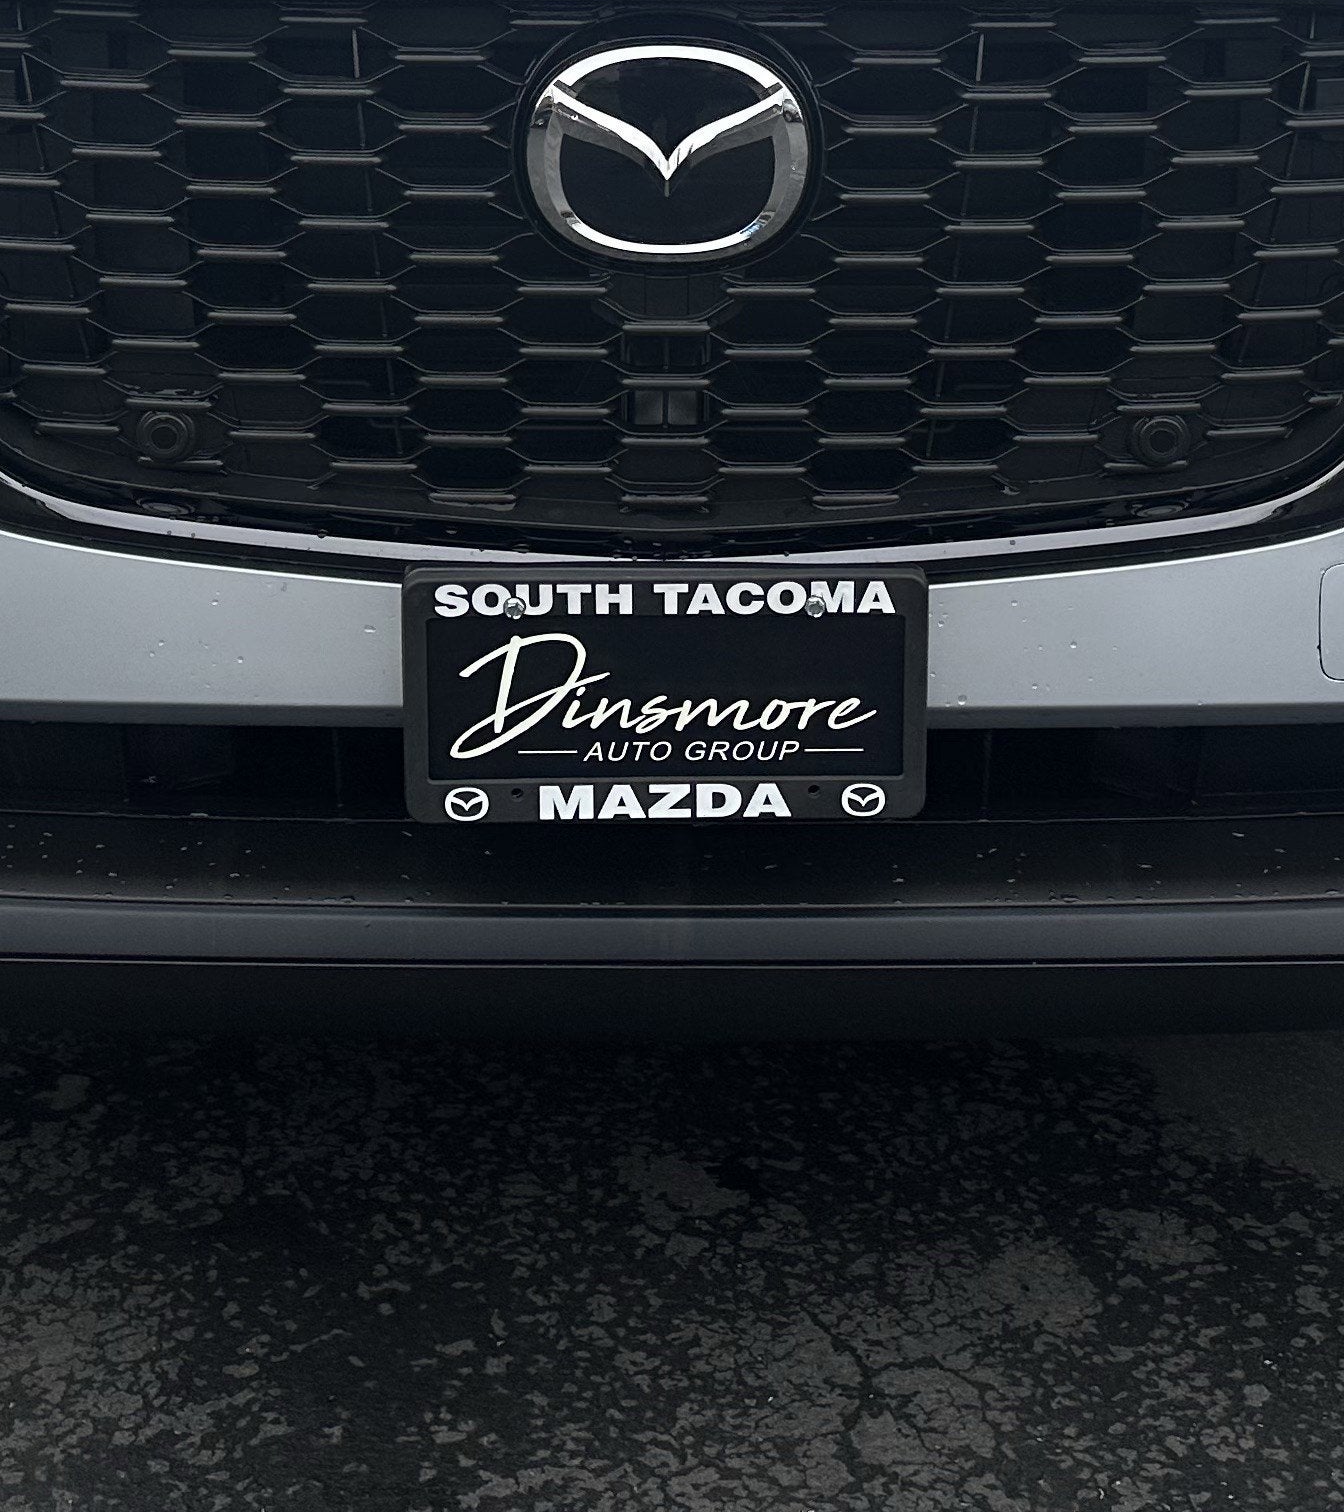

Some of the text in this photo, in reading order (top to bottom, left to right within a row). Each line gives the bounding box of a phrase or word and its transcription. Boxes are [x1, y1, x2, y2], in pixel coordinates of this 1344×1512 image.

[433, 580, 896, 618] SOUTH TACOMA
[449, 633, 877, 759] Dinsmore
[582, 739, 800, 762] AUTO GROUP
[538, 782, 792, 821] MAZDA
